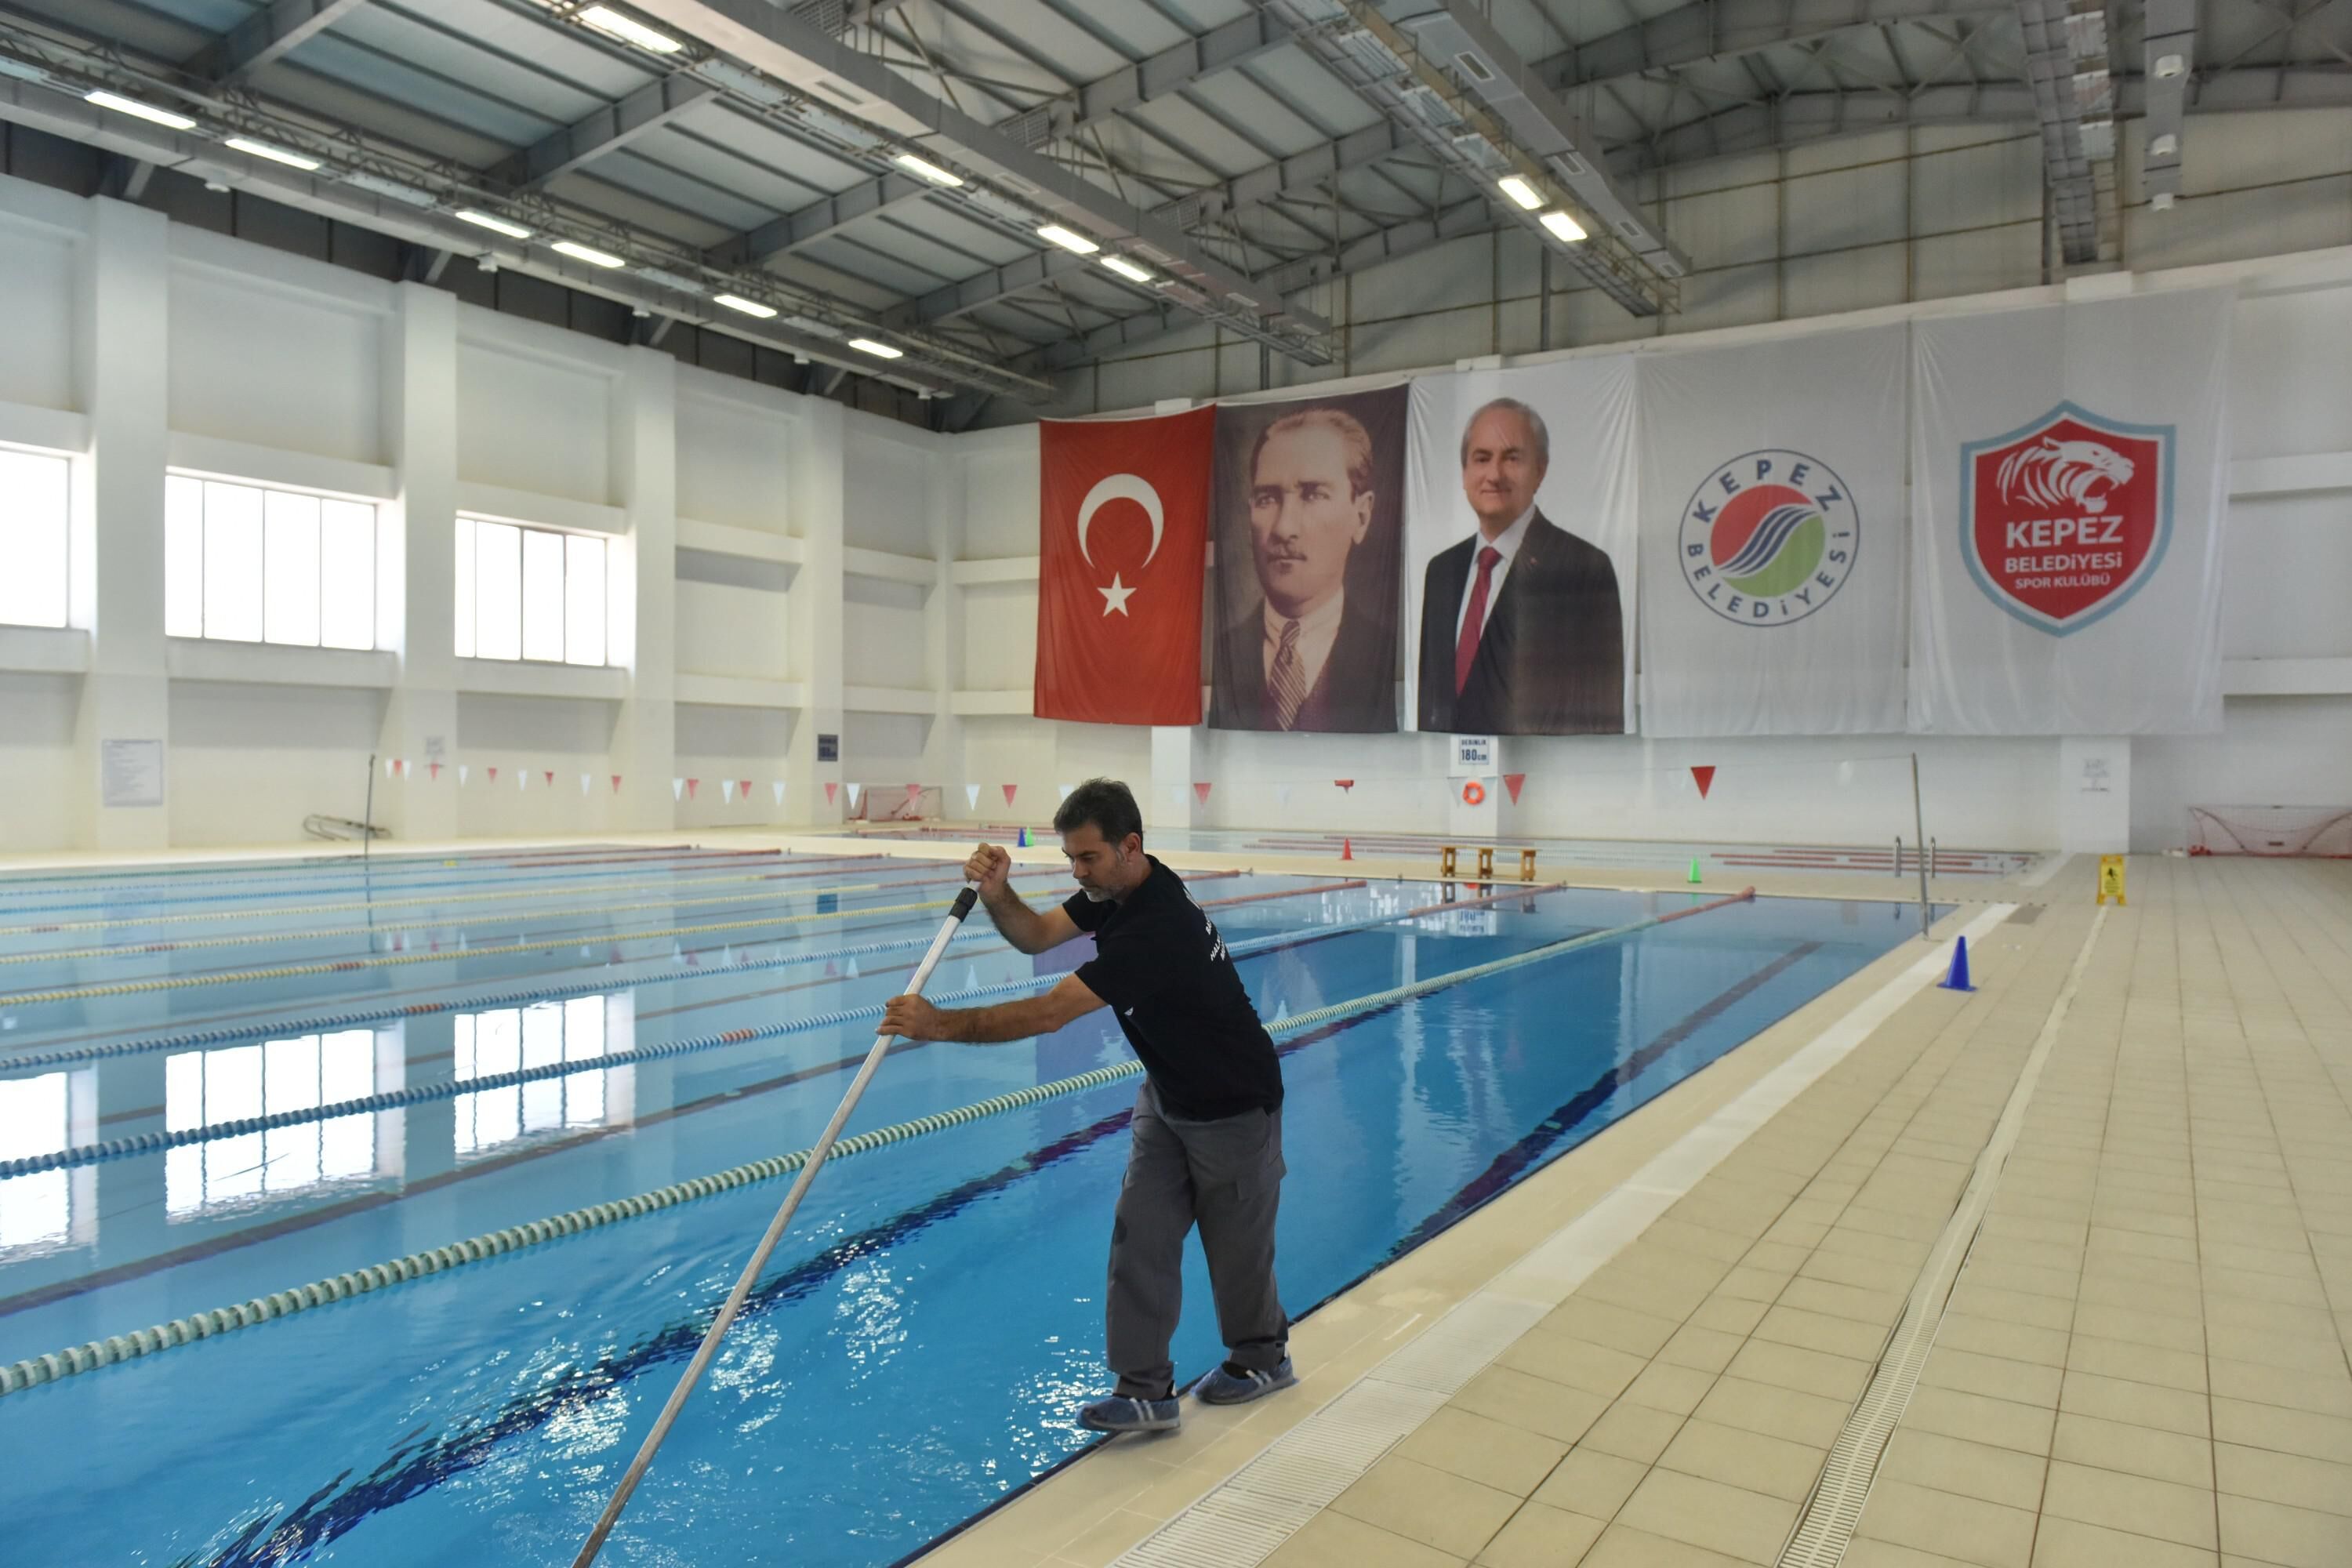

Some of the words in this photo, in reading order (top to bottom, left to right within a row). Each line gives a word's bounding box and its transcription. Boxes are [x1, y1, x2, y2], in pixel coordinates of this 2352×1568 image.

[1692, 459, 1842, 523] KEPEZ
[2005, 515, 2124, 549] KEPEZ
[2015, 576, 2052, 589] SPOR
[2053, 573, 2111, 588] KULÜBÜ
